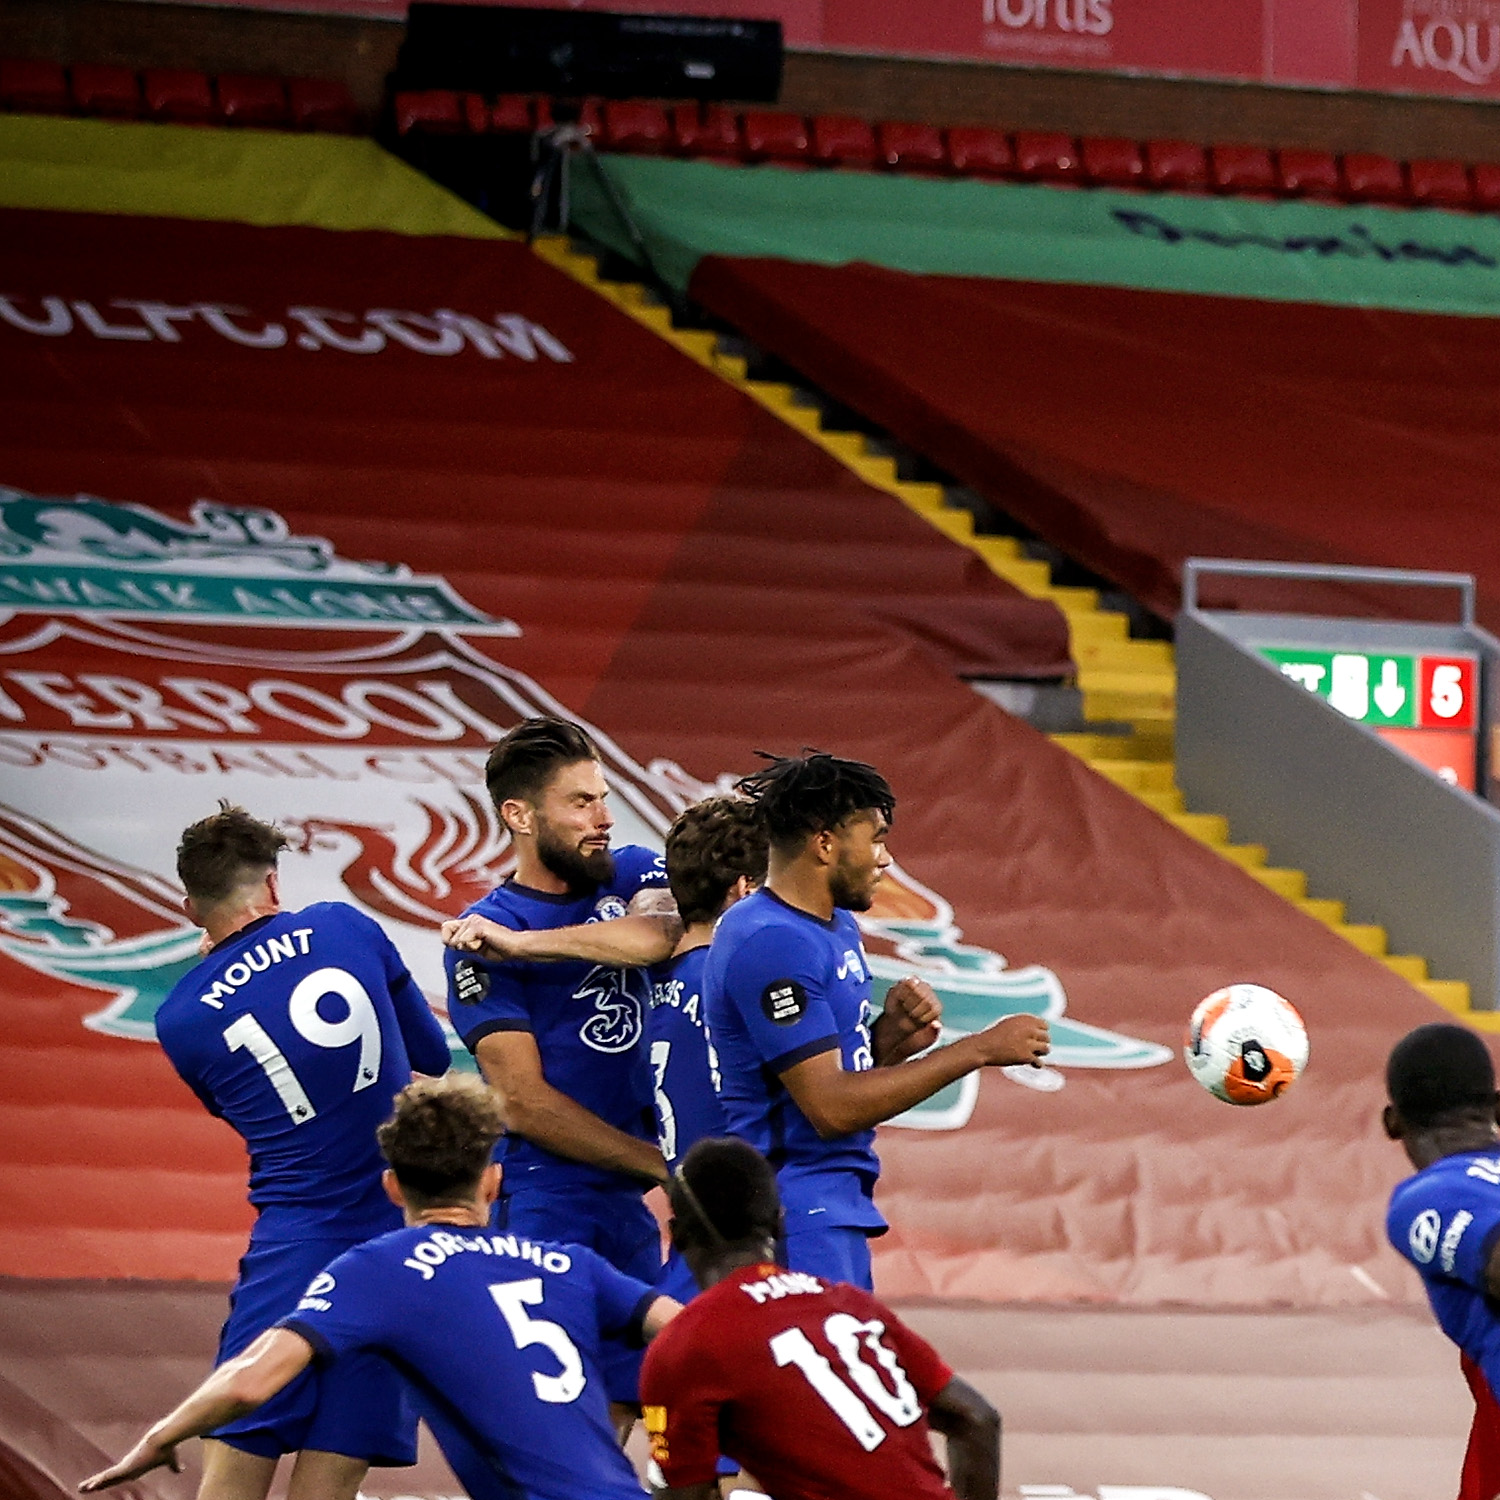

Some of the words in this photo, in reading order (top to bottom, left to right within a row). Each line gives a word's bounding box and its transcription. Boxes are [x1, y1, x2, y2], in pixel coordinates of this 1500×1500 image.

[0, 670, 512, 742] ERPOOL
[1430, 665, 1464, 718] 5
[200, 928, 314, 1010] MOUNT
[222, 966, 382, 1126] 19
[487, 1277, 587, 1403] 5
[768, 1312, 923, 1452] 10
